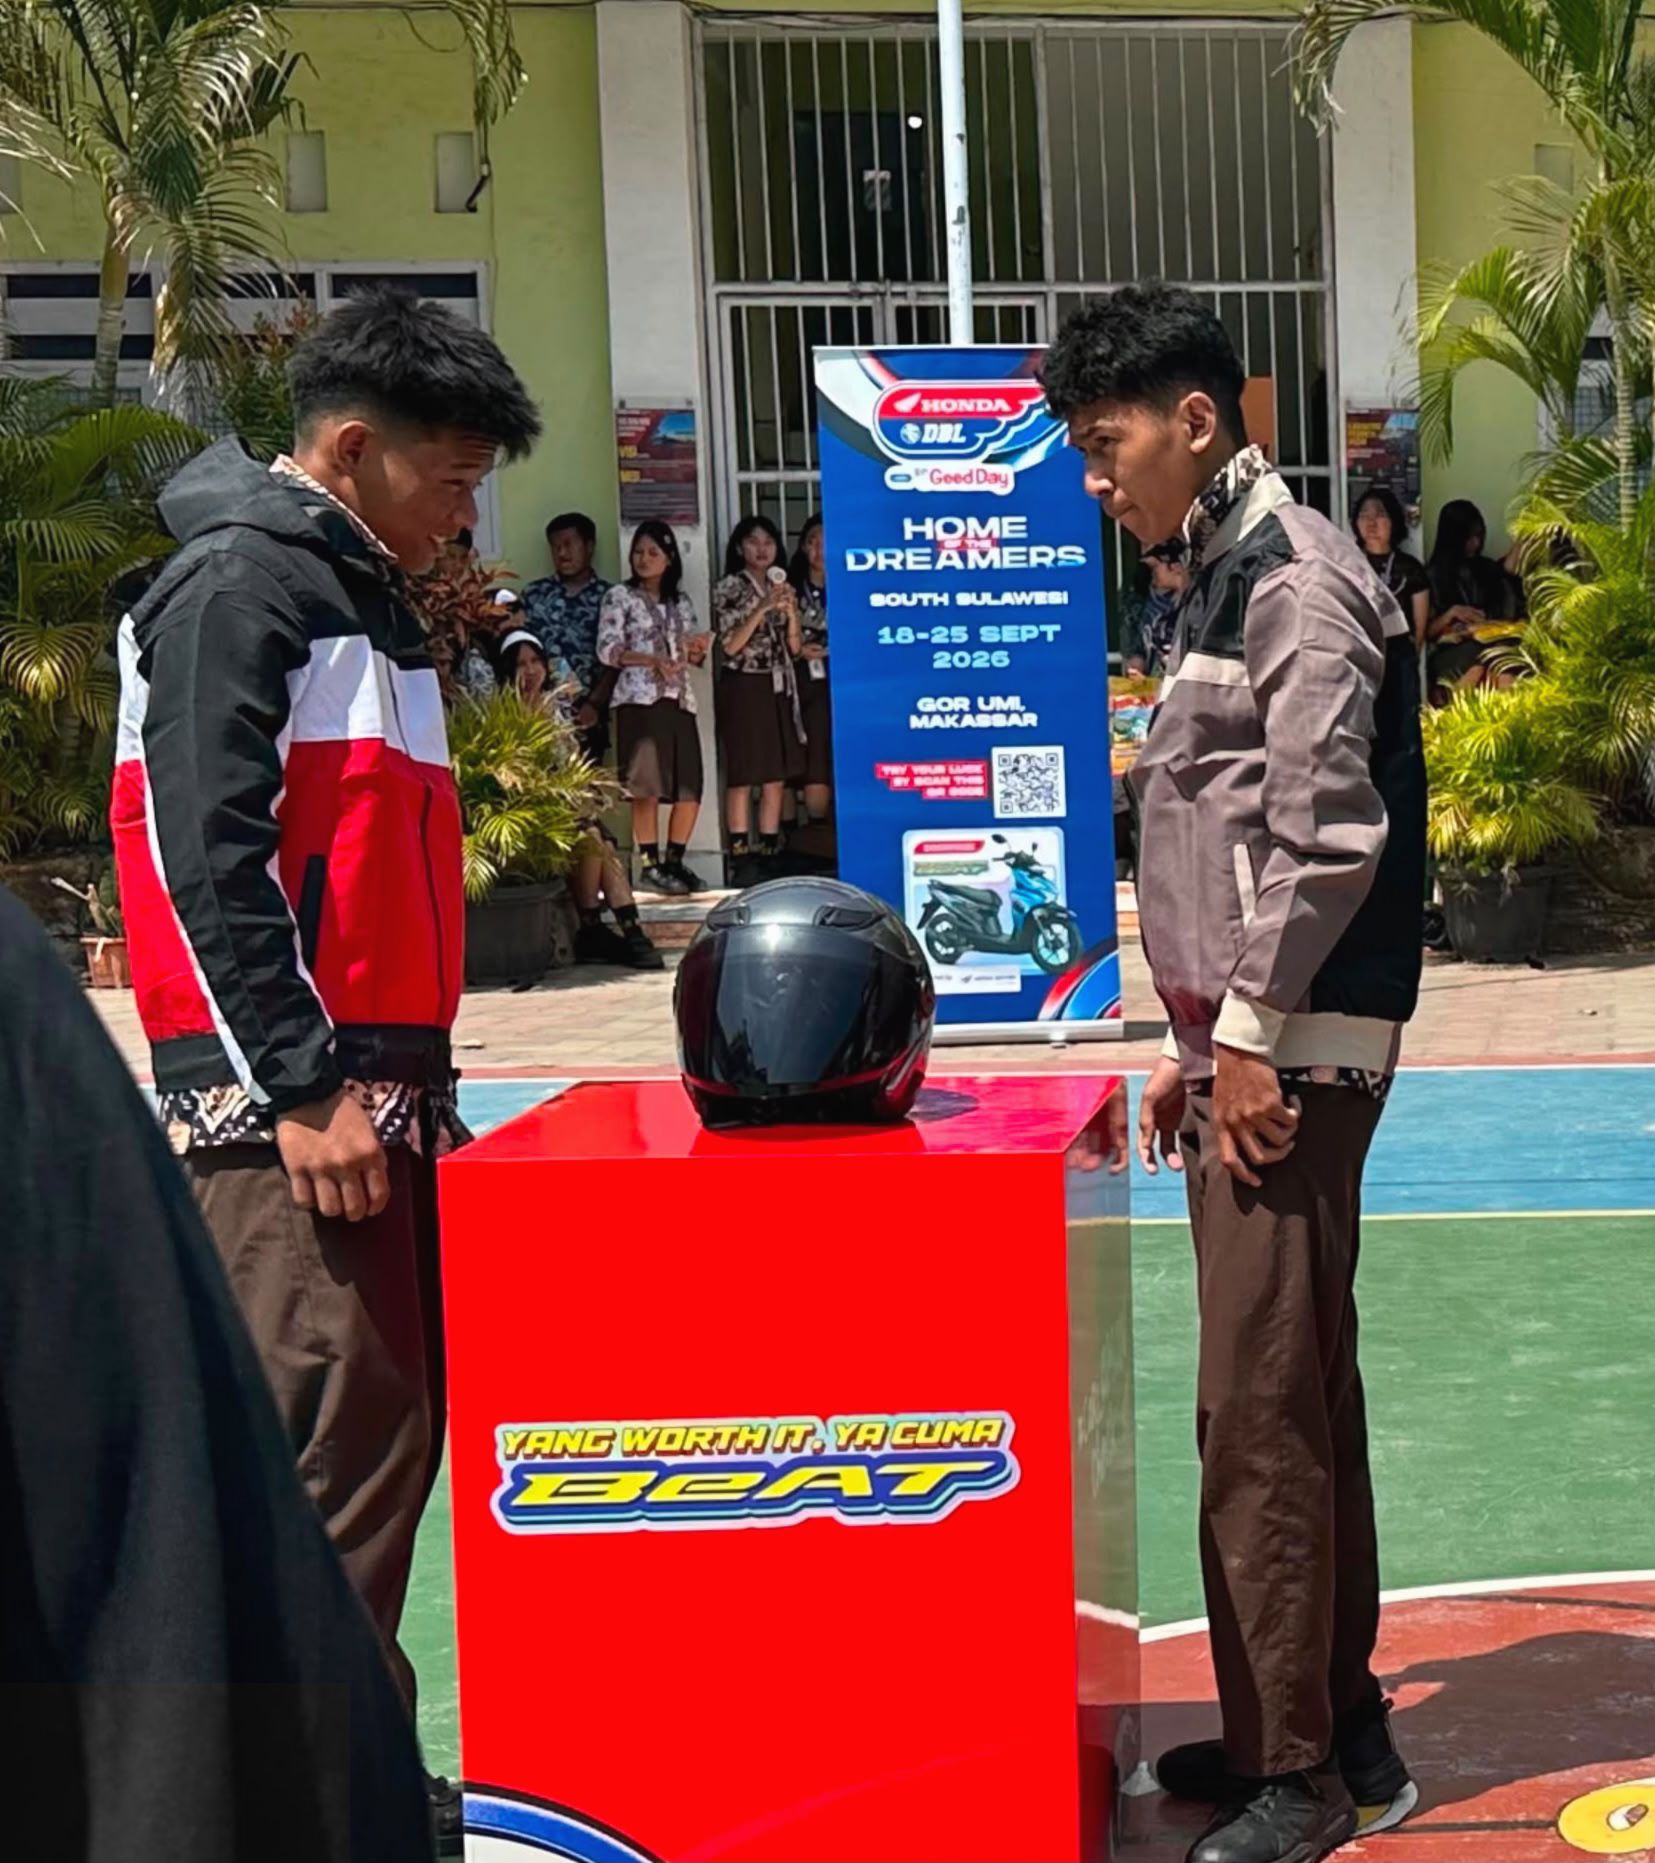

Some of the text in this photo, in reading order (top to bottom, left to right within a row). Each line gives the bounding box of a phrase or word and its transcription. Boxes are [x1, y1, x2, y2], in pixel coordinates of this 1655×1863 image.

[921, 398, 1012, 413] HONDA
[921, 423, 967, 444] DBL
[976, 468, 1009, 488] Day
[903, 516, 1028, 541] HOME
[845, 545, 1087, 571] DREAMERS
[869, 590, 1069, 607] SOUTH SULAWESI
[877, 624, 1062, 644] 18-25 SEPT
[932, 650, 1011, 669] 2026
[916, 696, 1026, 713] GOR UMI,
[909, 713, 1038, 730] MAKASSAR
[503, 1429, 613, 1460] YANG
[621, 1424, 768, 1456] WORTH
[835, 1419, 885, 1449] YA
[890, 1417, 1005, 1447] CUMA
